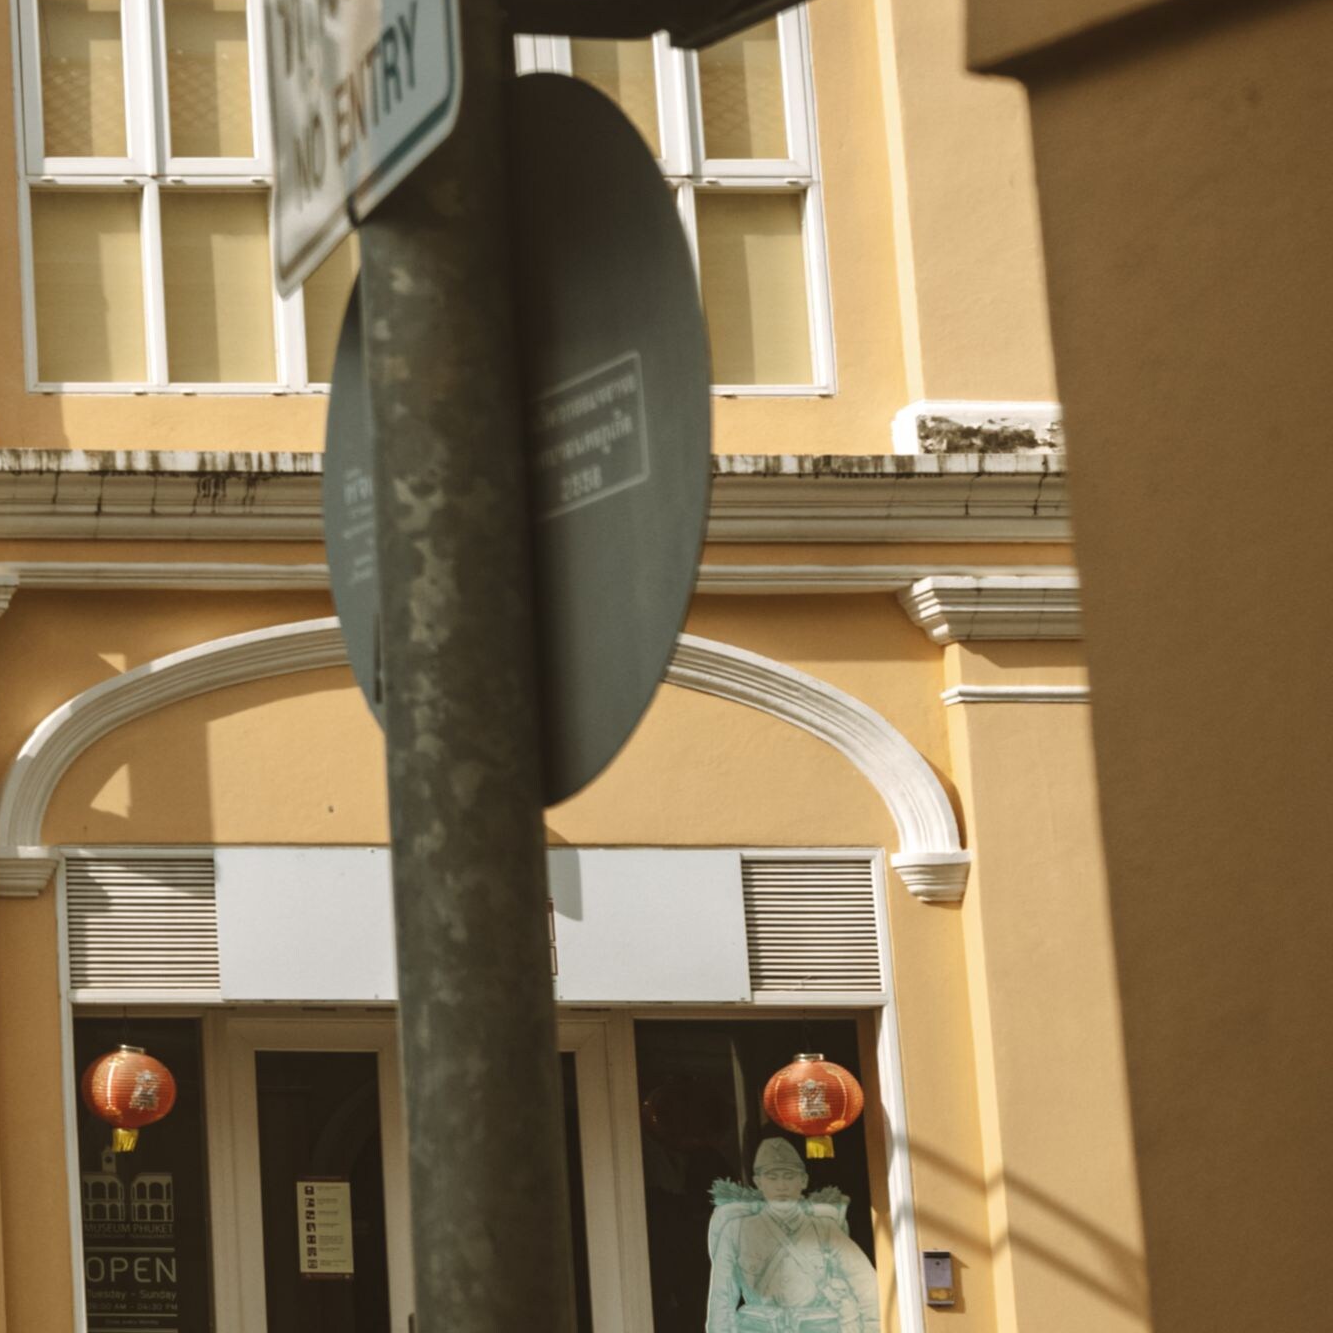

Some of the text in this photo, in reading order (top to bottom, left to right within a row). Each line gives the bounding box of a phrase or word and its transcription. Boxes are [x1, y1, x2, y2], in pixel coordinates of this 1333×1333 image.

[295, 0, 418, 213] NO ENTRY
[84, 1223, 173, 1234] MUSEUM PHUKET
[85, 1256, 177, 1283] OPEN
[139, 1290, 177, 1301] Sunday
